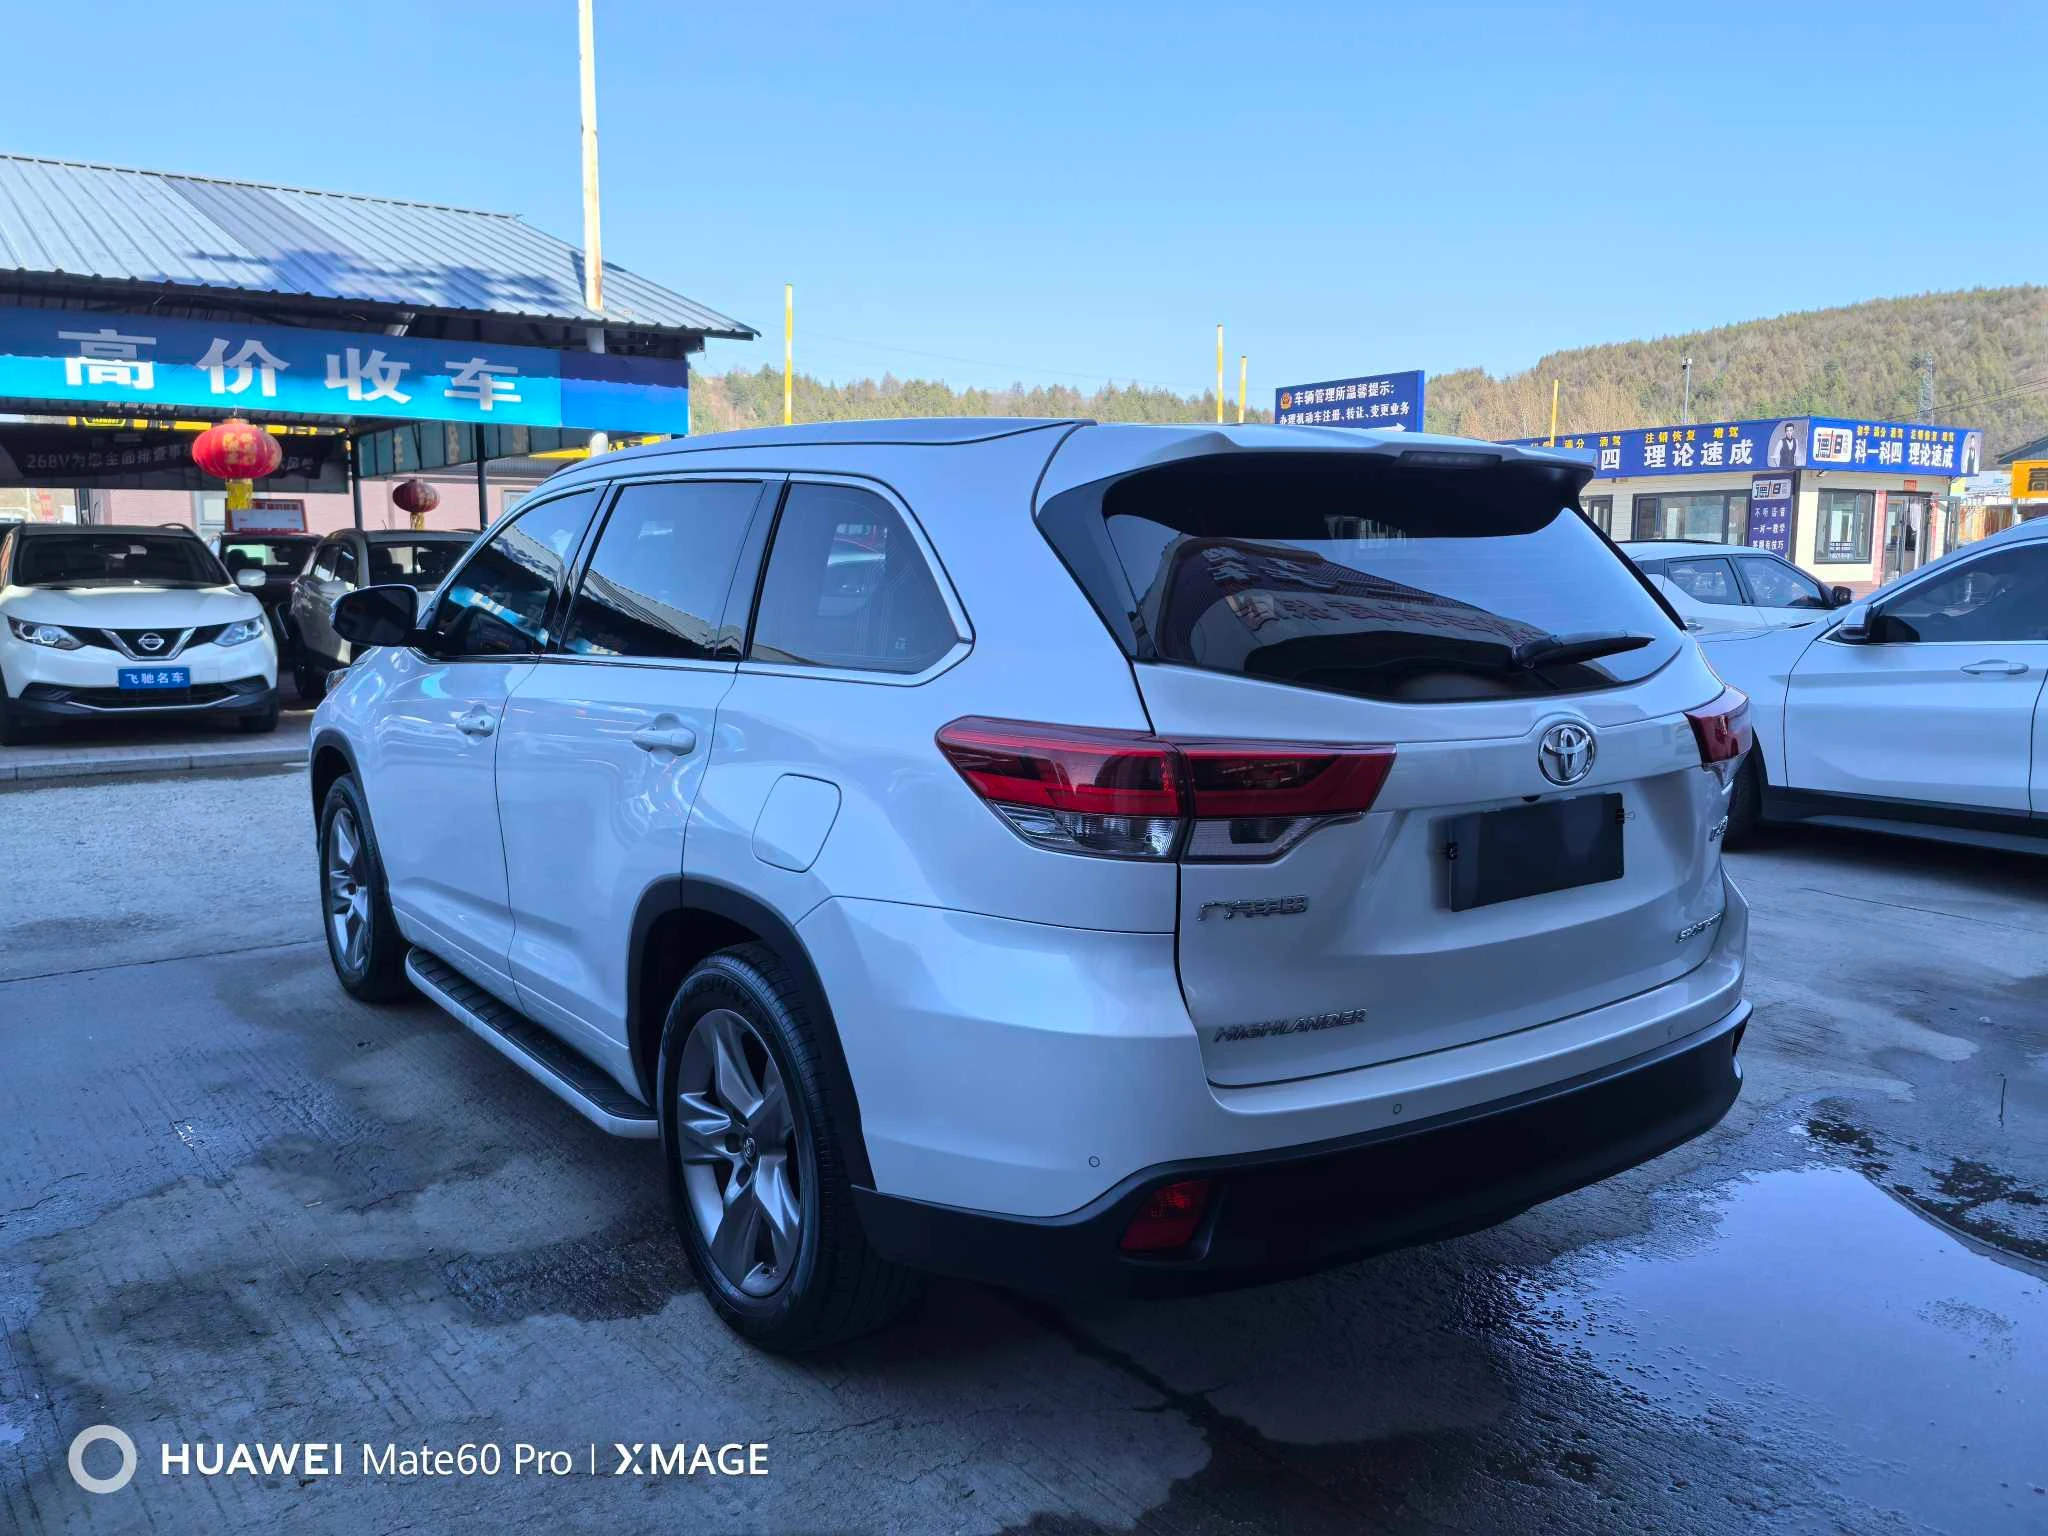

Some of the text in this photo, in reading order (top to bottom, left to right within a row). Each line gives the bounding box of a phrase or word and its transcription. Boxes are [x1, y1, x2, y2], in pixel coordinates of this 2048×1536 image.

[58, 329, 523, 412] 高价收车
[1600, 439, 1755, 470] 四 理论速成
[1854, 438, 1903, 465] 科一科四
[1908, 442, 1954, 469] 理论速成
[124, 671, 185, 685] 飞驰名车
[1212, 1008, 1369, 1043] HIGHLANDER
